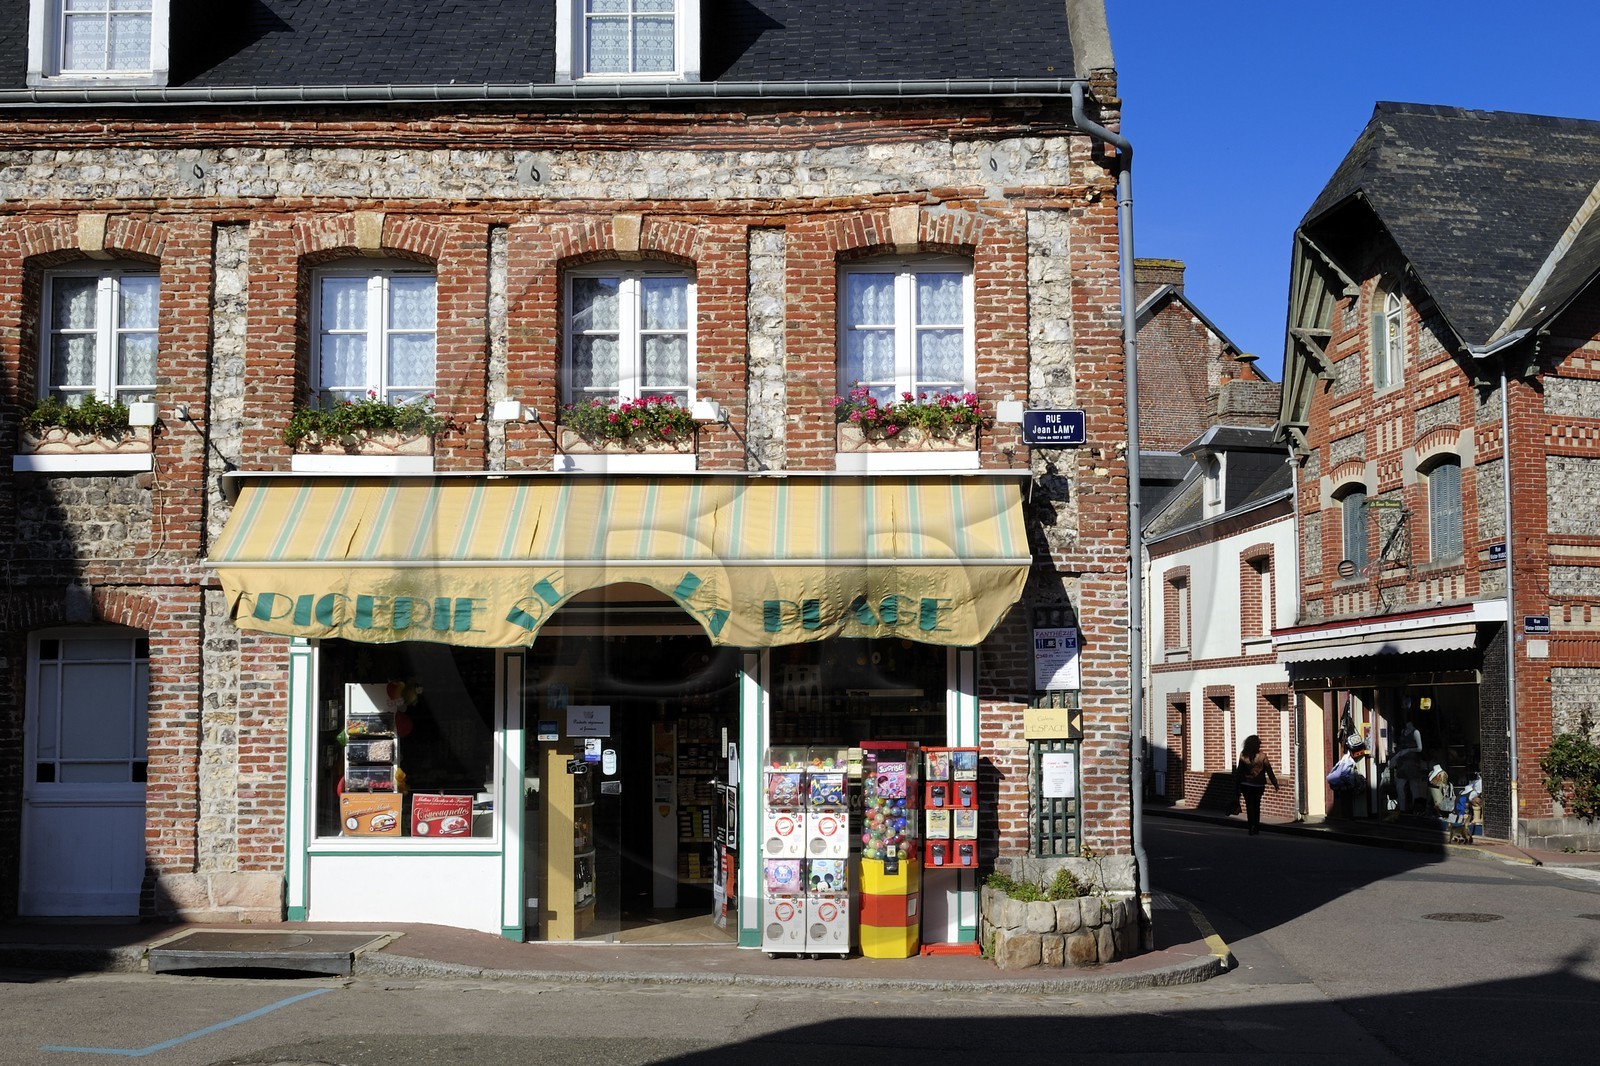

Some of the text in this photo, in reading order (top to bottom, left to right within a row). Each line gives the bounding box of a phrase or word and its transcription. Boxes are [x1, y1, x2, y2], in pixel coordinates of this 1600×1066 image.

[1045, 414, 1062, 424] RUE
[1032, 425, 1075, 434] Jean LAMY
[506, 569, 573, 631] DE
[673, 571, 731, 638] LA
[763, 594, 953, 632] PLAGE
